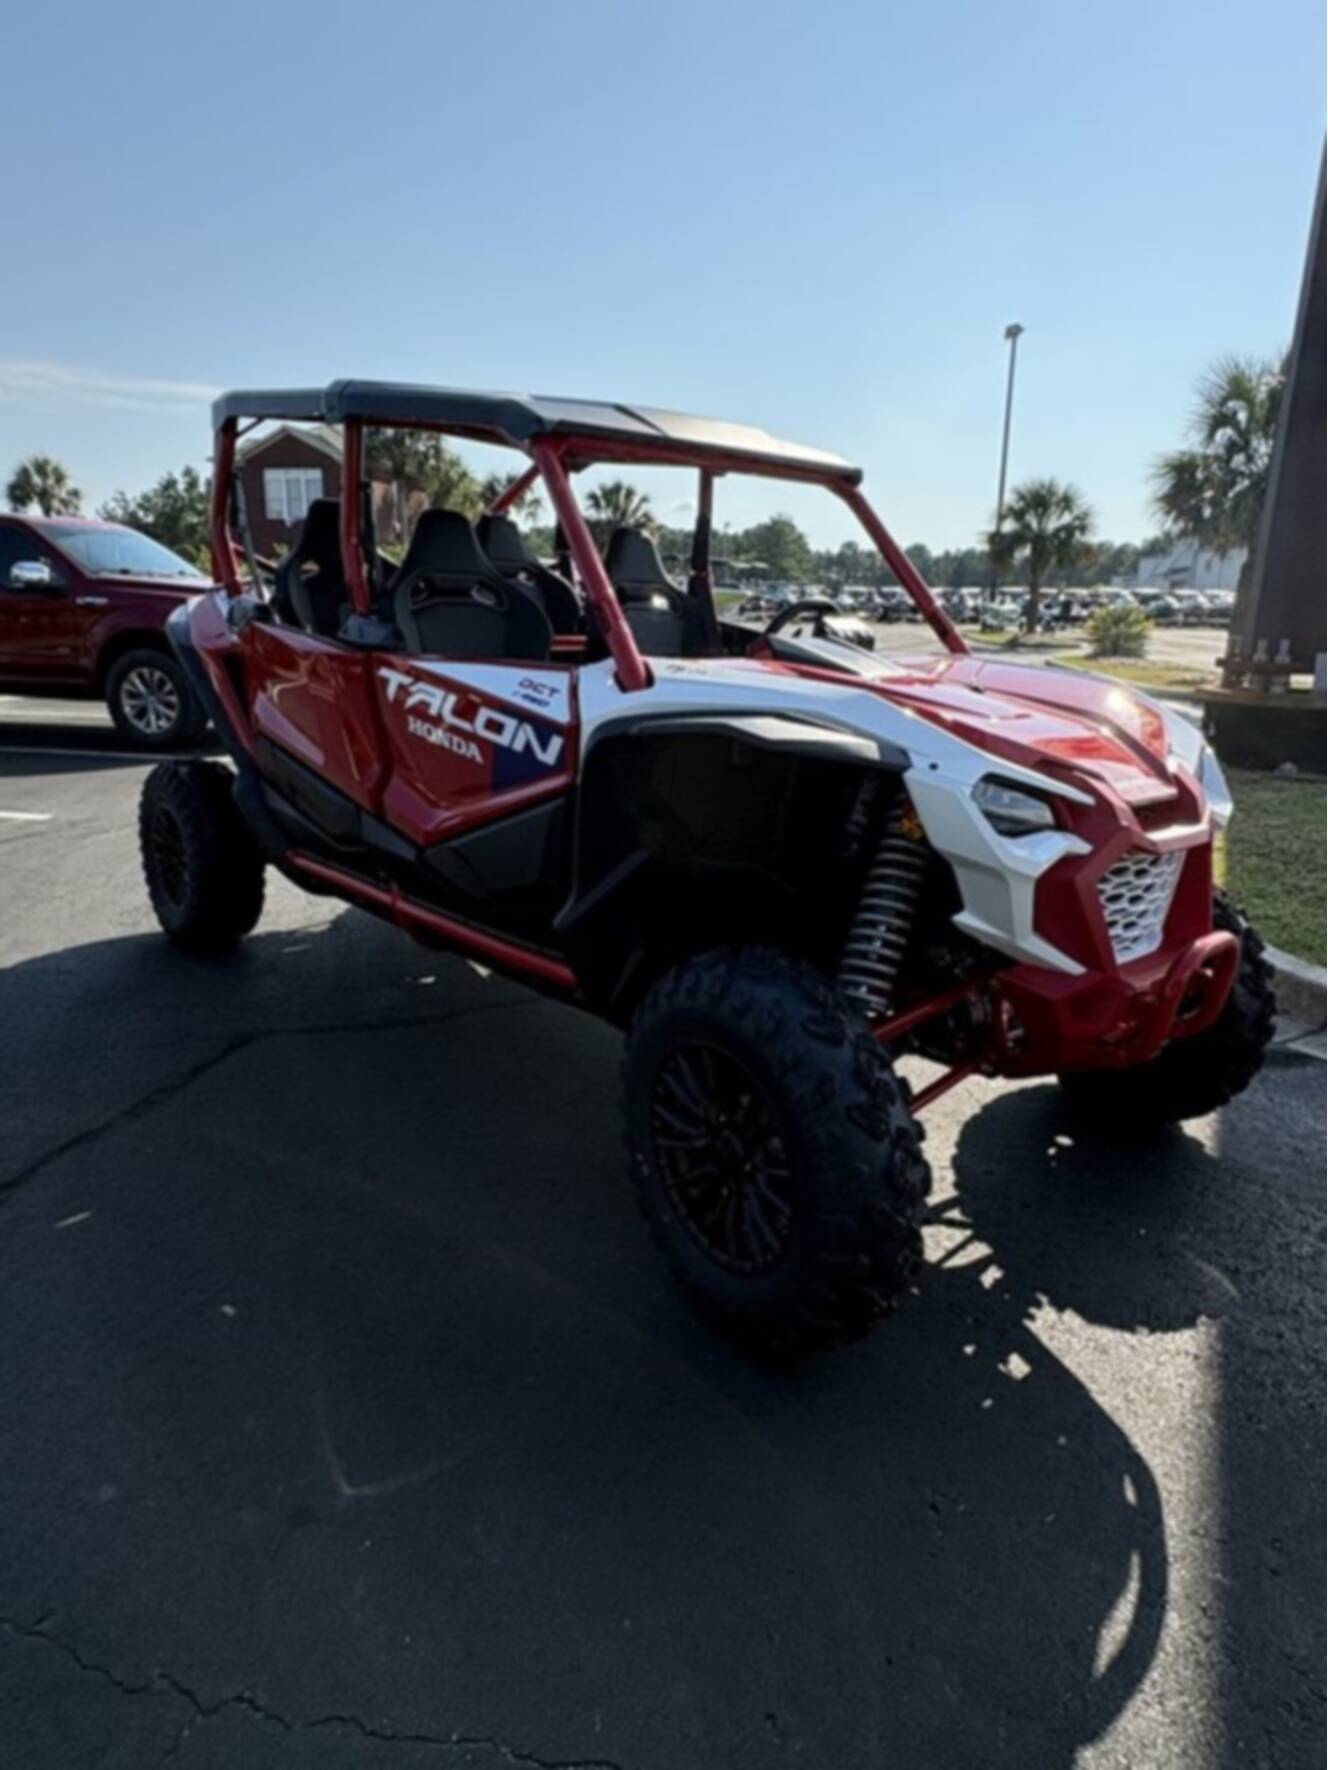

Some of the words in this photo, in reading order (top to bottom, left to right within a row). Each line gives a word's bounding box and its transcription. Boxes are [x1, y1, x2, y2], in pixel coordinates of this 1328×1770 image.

[518, 677, 561, 698] DCT
[378, 667, 563, 766] TALON
[407, 716, 484, 765] HONDA
